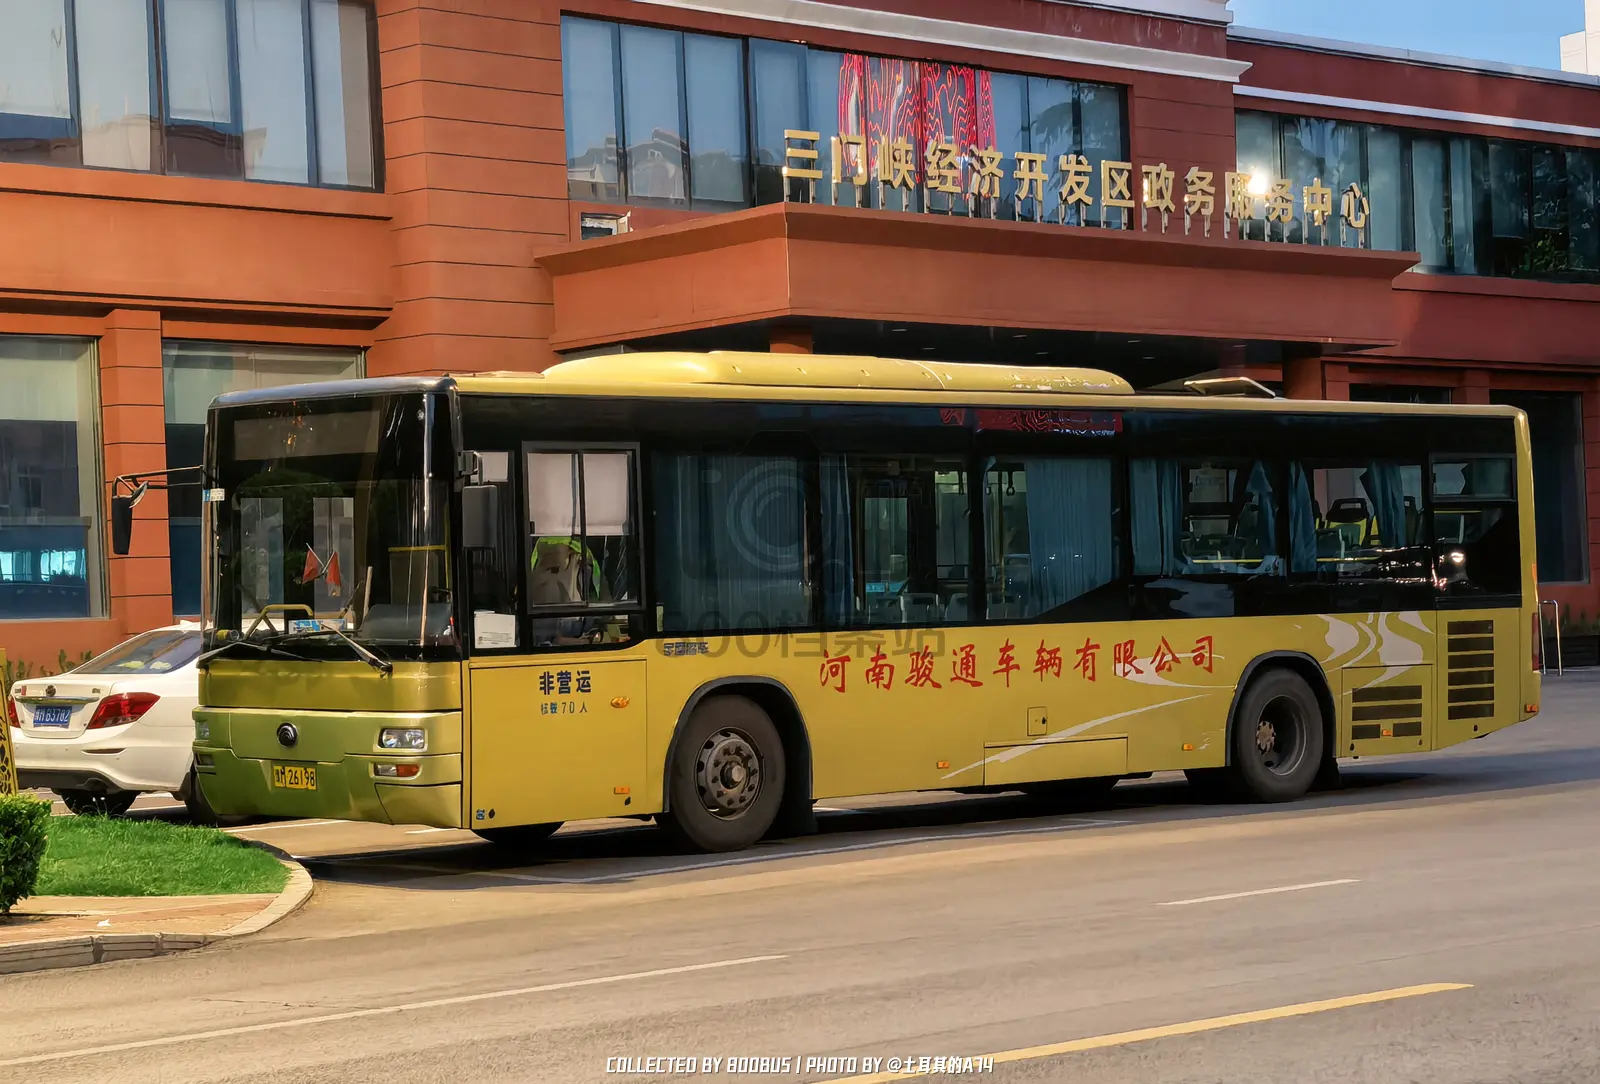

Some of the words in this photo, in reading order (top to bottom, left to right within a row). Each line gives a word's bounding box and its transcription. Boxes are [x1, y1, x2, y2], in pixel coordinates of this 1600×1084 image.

[782, 129, 1370, 229] 三门峡经济开发区政务服务中心
[538, 670, 592, 695] 非营运
[819, 635, 1213, 693] 河南骏通车辆有限公司
